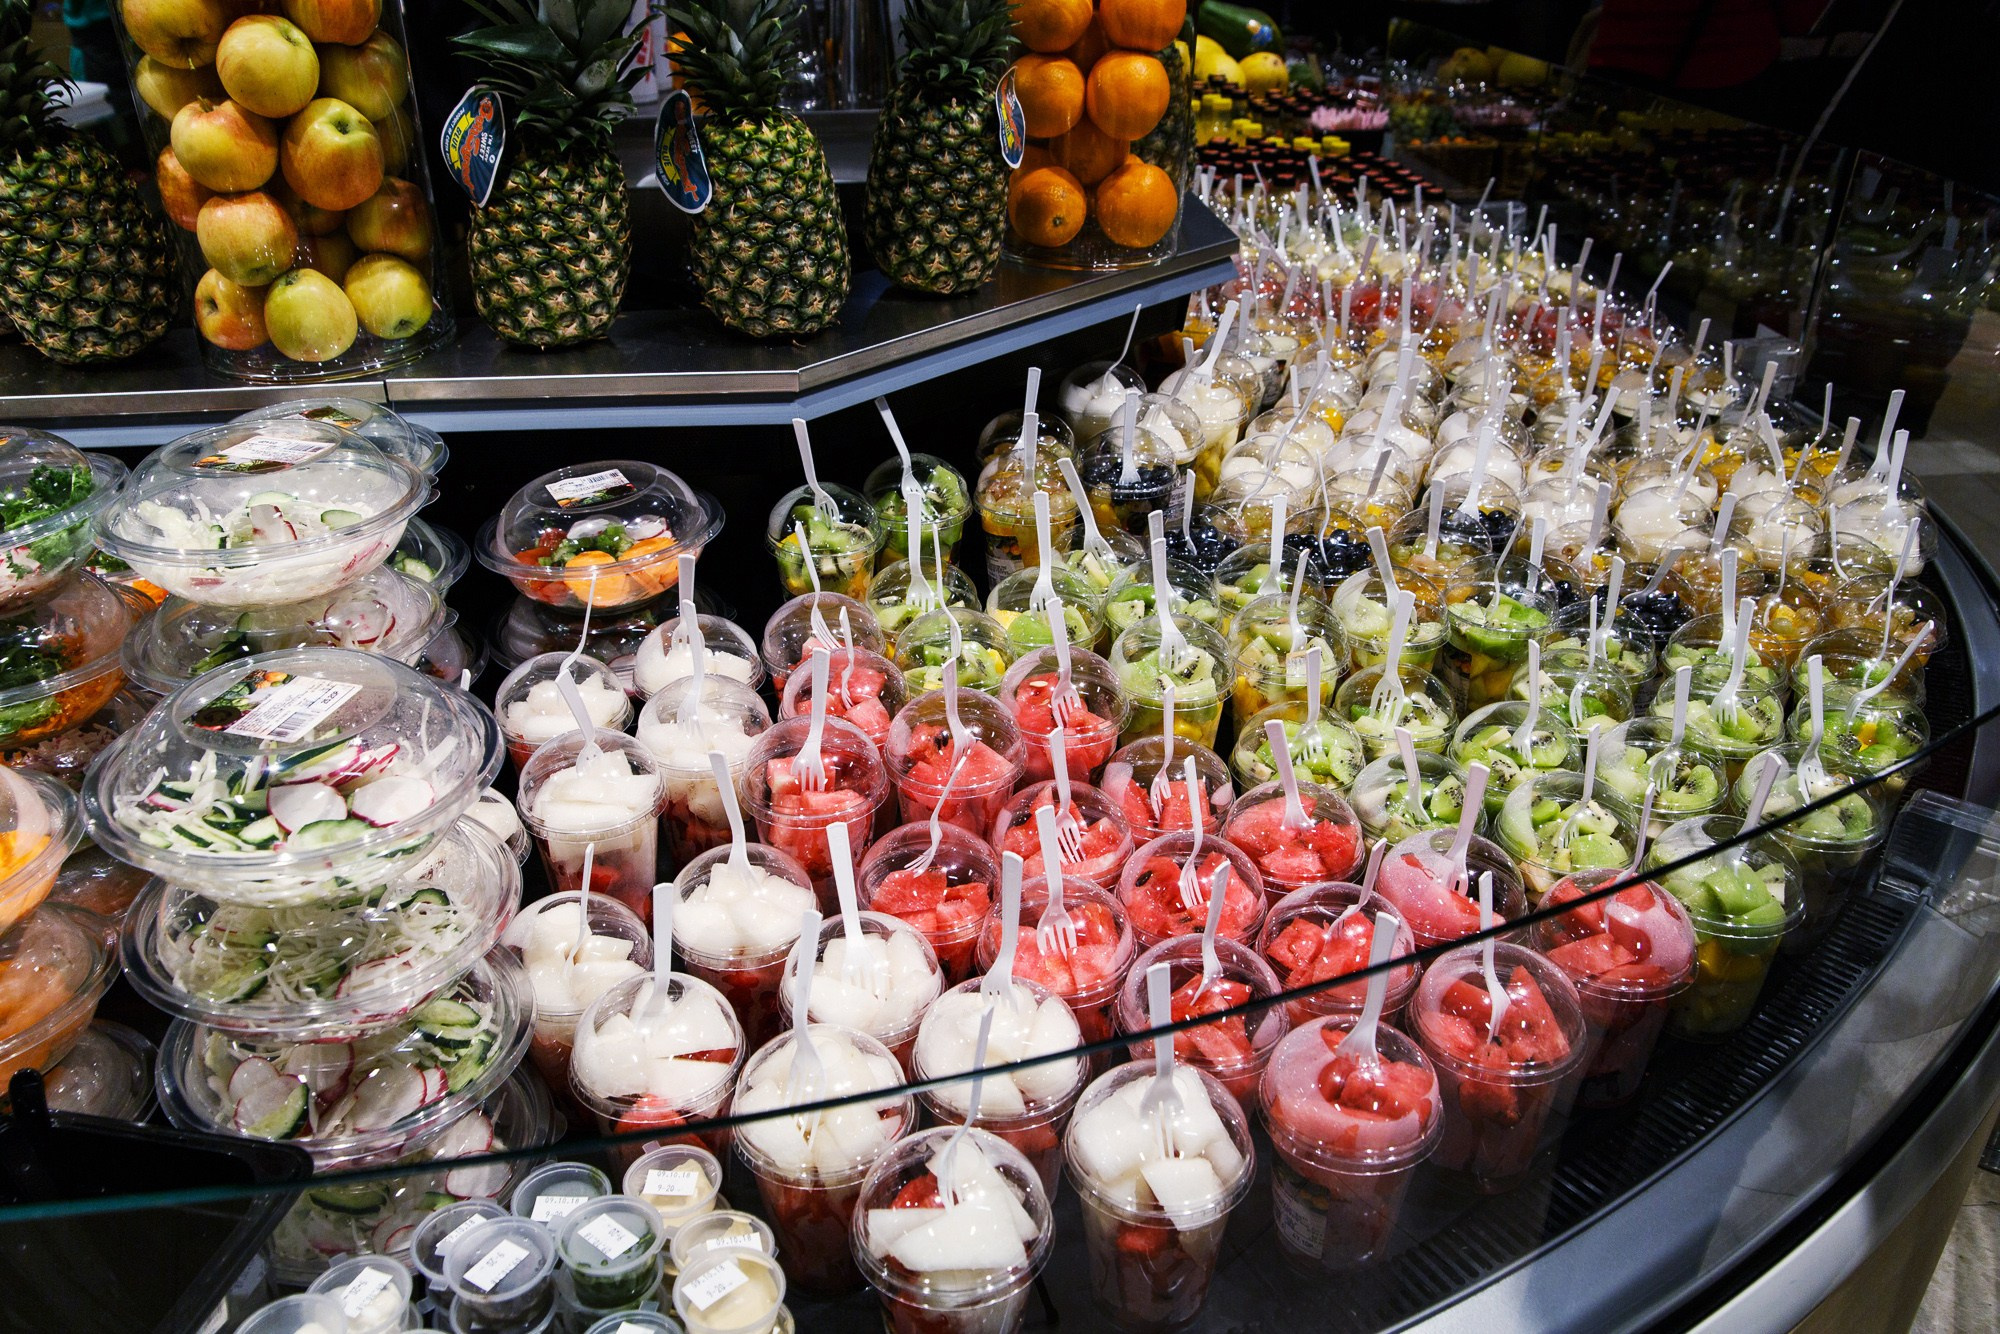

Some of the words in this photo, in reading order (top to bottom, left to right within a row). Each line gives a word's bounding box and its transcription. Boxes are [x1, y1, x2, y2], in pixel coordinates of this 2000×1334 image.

[451, 127, 463, 151] BLUE
[479, 132, 488, 161] SWEET
[687, 129, 698, 154] SWEET
[662, 144, 672, 167] BLUE
[544, 1197, 580, 1205] 09.10.18
[715, 1234, 752, 1247] 09.10.18
[690, 1264, 725, 1288] 09.10.18
